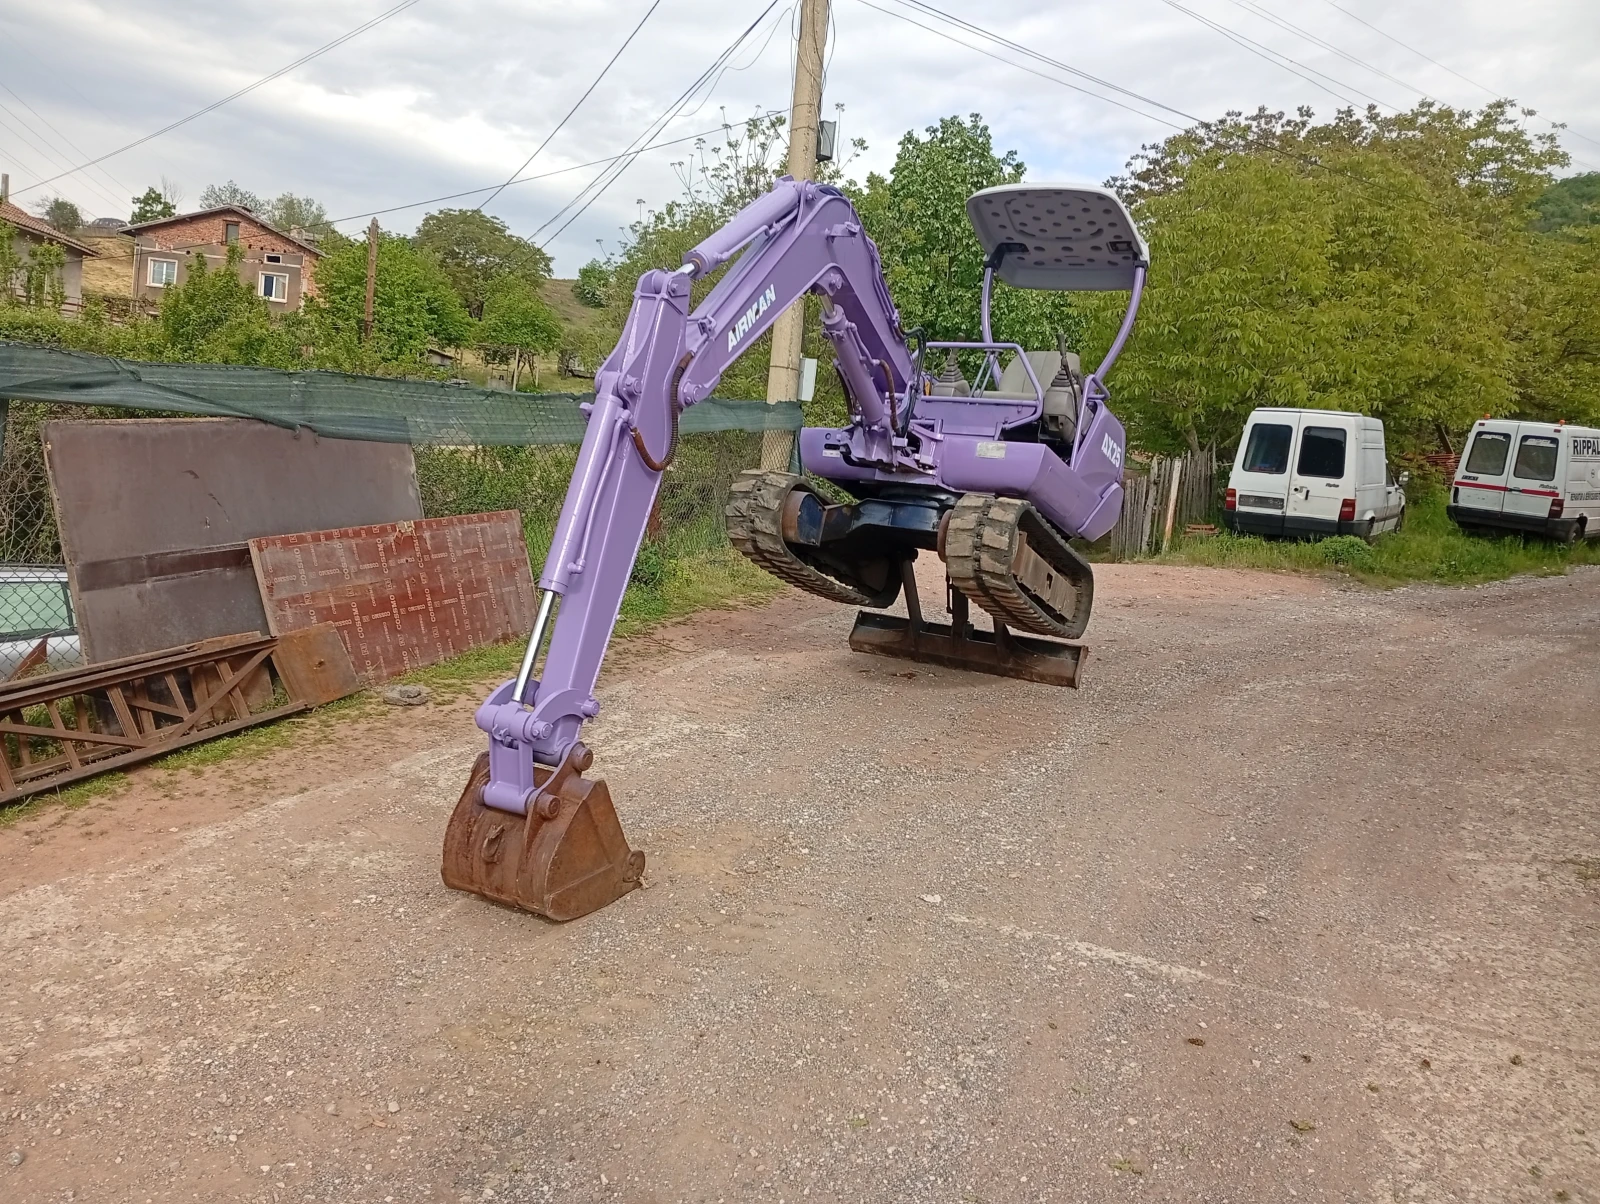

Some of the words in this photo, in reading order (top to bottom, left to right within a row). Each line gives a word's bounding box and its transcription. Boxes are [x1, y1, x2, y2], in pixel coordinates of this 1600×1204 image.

[728, 284, 776, 353] AIRMAN
[1101, 432, 1122, 468] AX25
[293, 548, 308, 587] COSSMO
[337, 542, 351, 580] COSSMO
[376, 537, 390, 574] COSSMO
[389, 594, 402, 630] COSSMO
[424, 588, 436, 623] COSSMO
[456, 582, 468, 615] COSSMO
[351, 601, 365, 639] COSSMO
